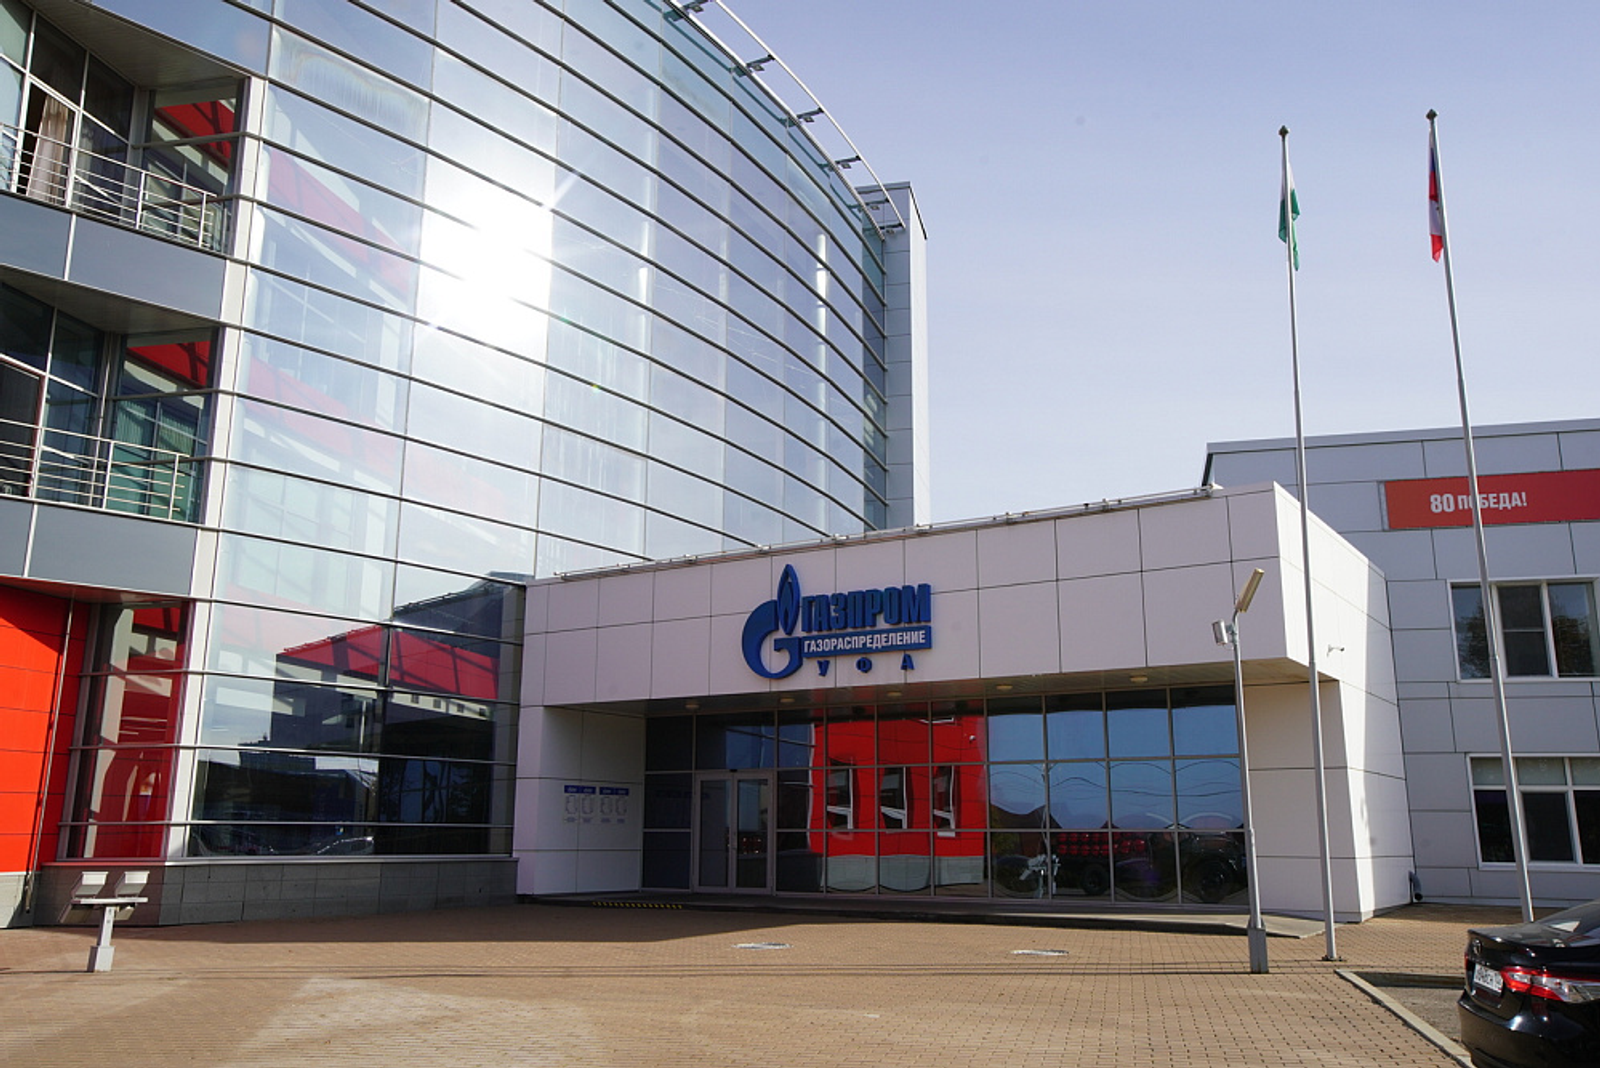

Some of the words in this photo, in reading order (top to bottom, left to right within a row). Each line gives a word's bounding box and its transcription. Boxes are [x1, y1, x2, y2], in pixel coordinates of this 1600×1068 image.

[1430, 493, 1455, 513] 80
[801, 583, 932, 633] ГАЗПРОМ
[804, 630, 926, 653] ГАЗОРАСПРЕДЕЛЕНИЕ
